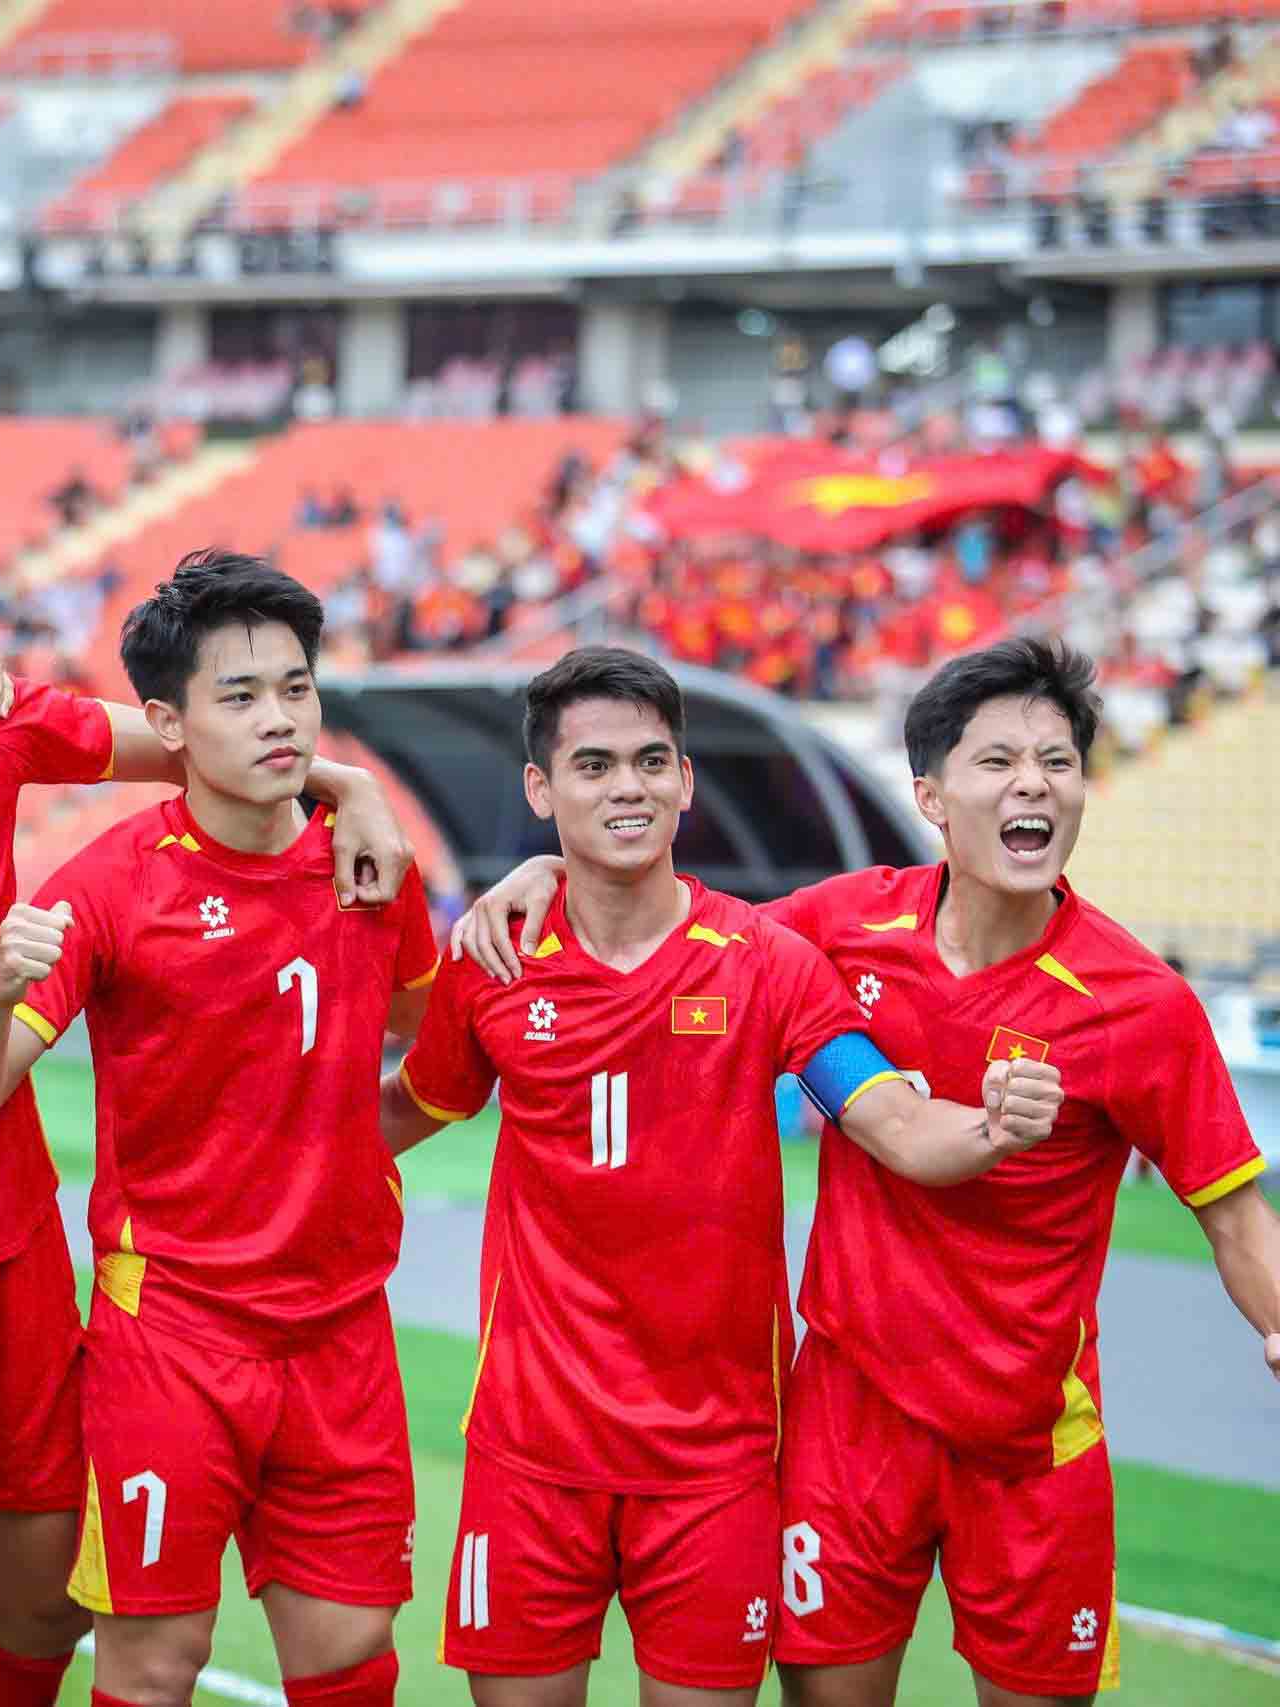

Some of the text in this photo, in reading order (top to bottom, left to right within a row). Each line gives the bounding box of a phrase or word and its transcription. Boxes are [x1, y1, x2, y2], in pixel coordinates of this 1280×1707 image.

[276, 956, 319, 1057] 7
[590, 1070, 628, 1170] 11
[122, 1470, 167, 1569] 7
[782, 1520, 825, 1617] 8
[458, 1531, 490, 1631] 11
